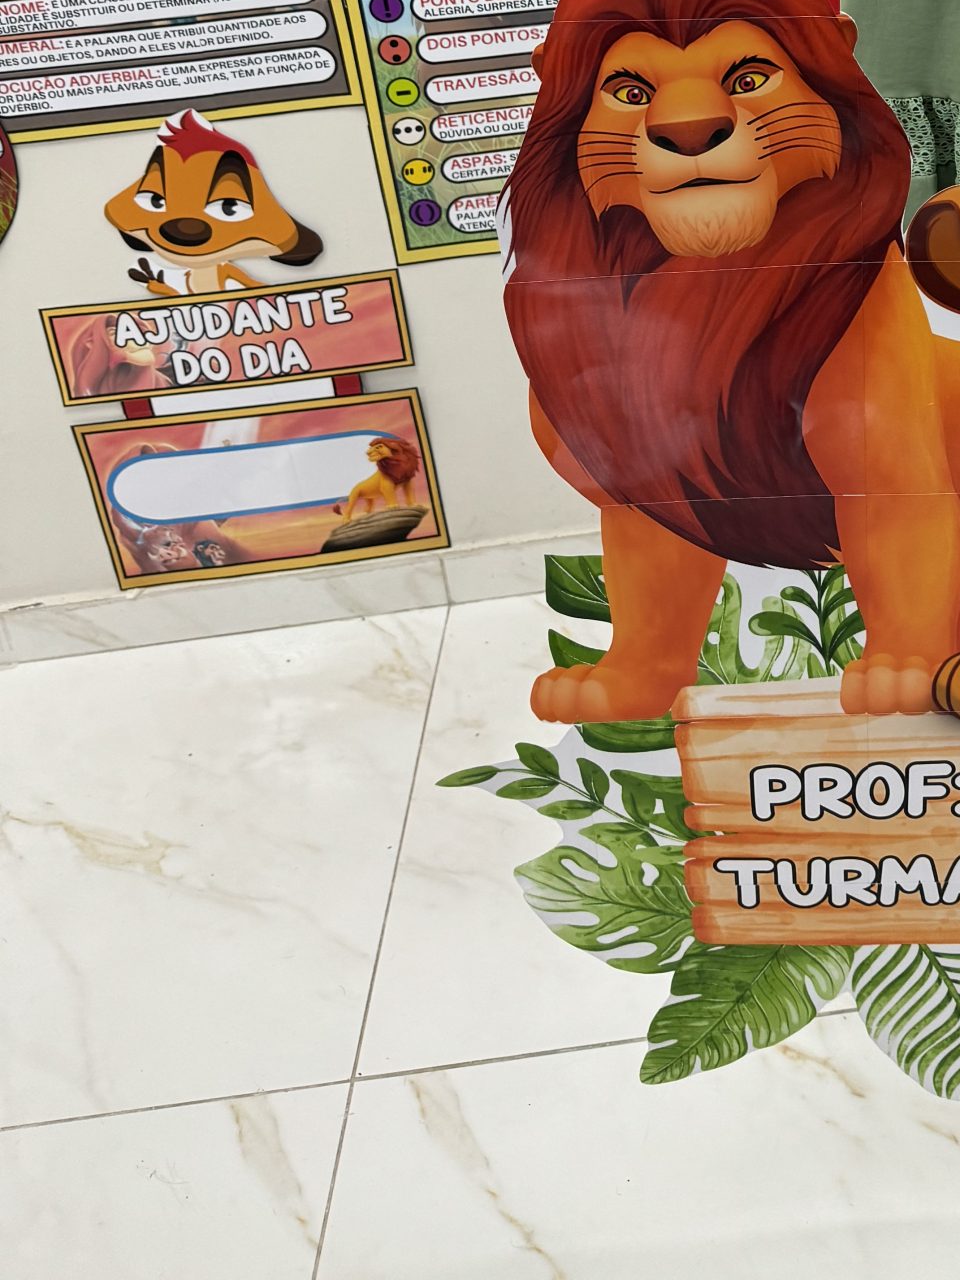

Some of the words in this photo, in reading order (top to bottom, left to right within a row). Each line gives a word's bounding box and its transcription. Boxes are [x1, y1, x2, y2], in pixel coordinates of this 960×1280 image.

[424, 6, 474, 17] ALEGRIA,
[477, 0, 534, 12] SURPRESA
[427, 36, 467, 50] DOIS
[471, 28, 544, 46] PONTOS:
[433, 70, 536, 92] TRAVESSÃO:
[440, 127, 482, 139] DÚVIDA
[484, 125, 499, 133] OU
[502, 122, 524, 131] QUE
[451, 154, 506, 170] ASPAS:
[451, 168, 488, 180] CERTA
[114, 286, 353, 348] AJUDANTE
[170, 349, 232, 387] DO
[240, 338, 312, 380] DIA
